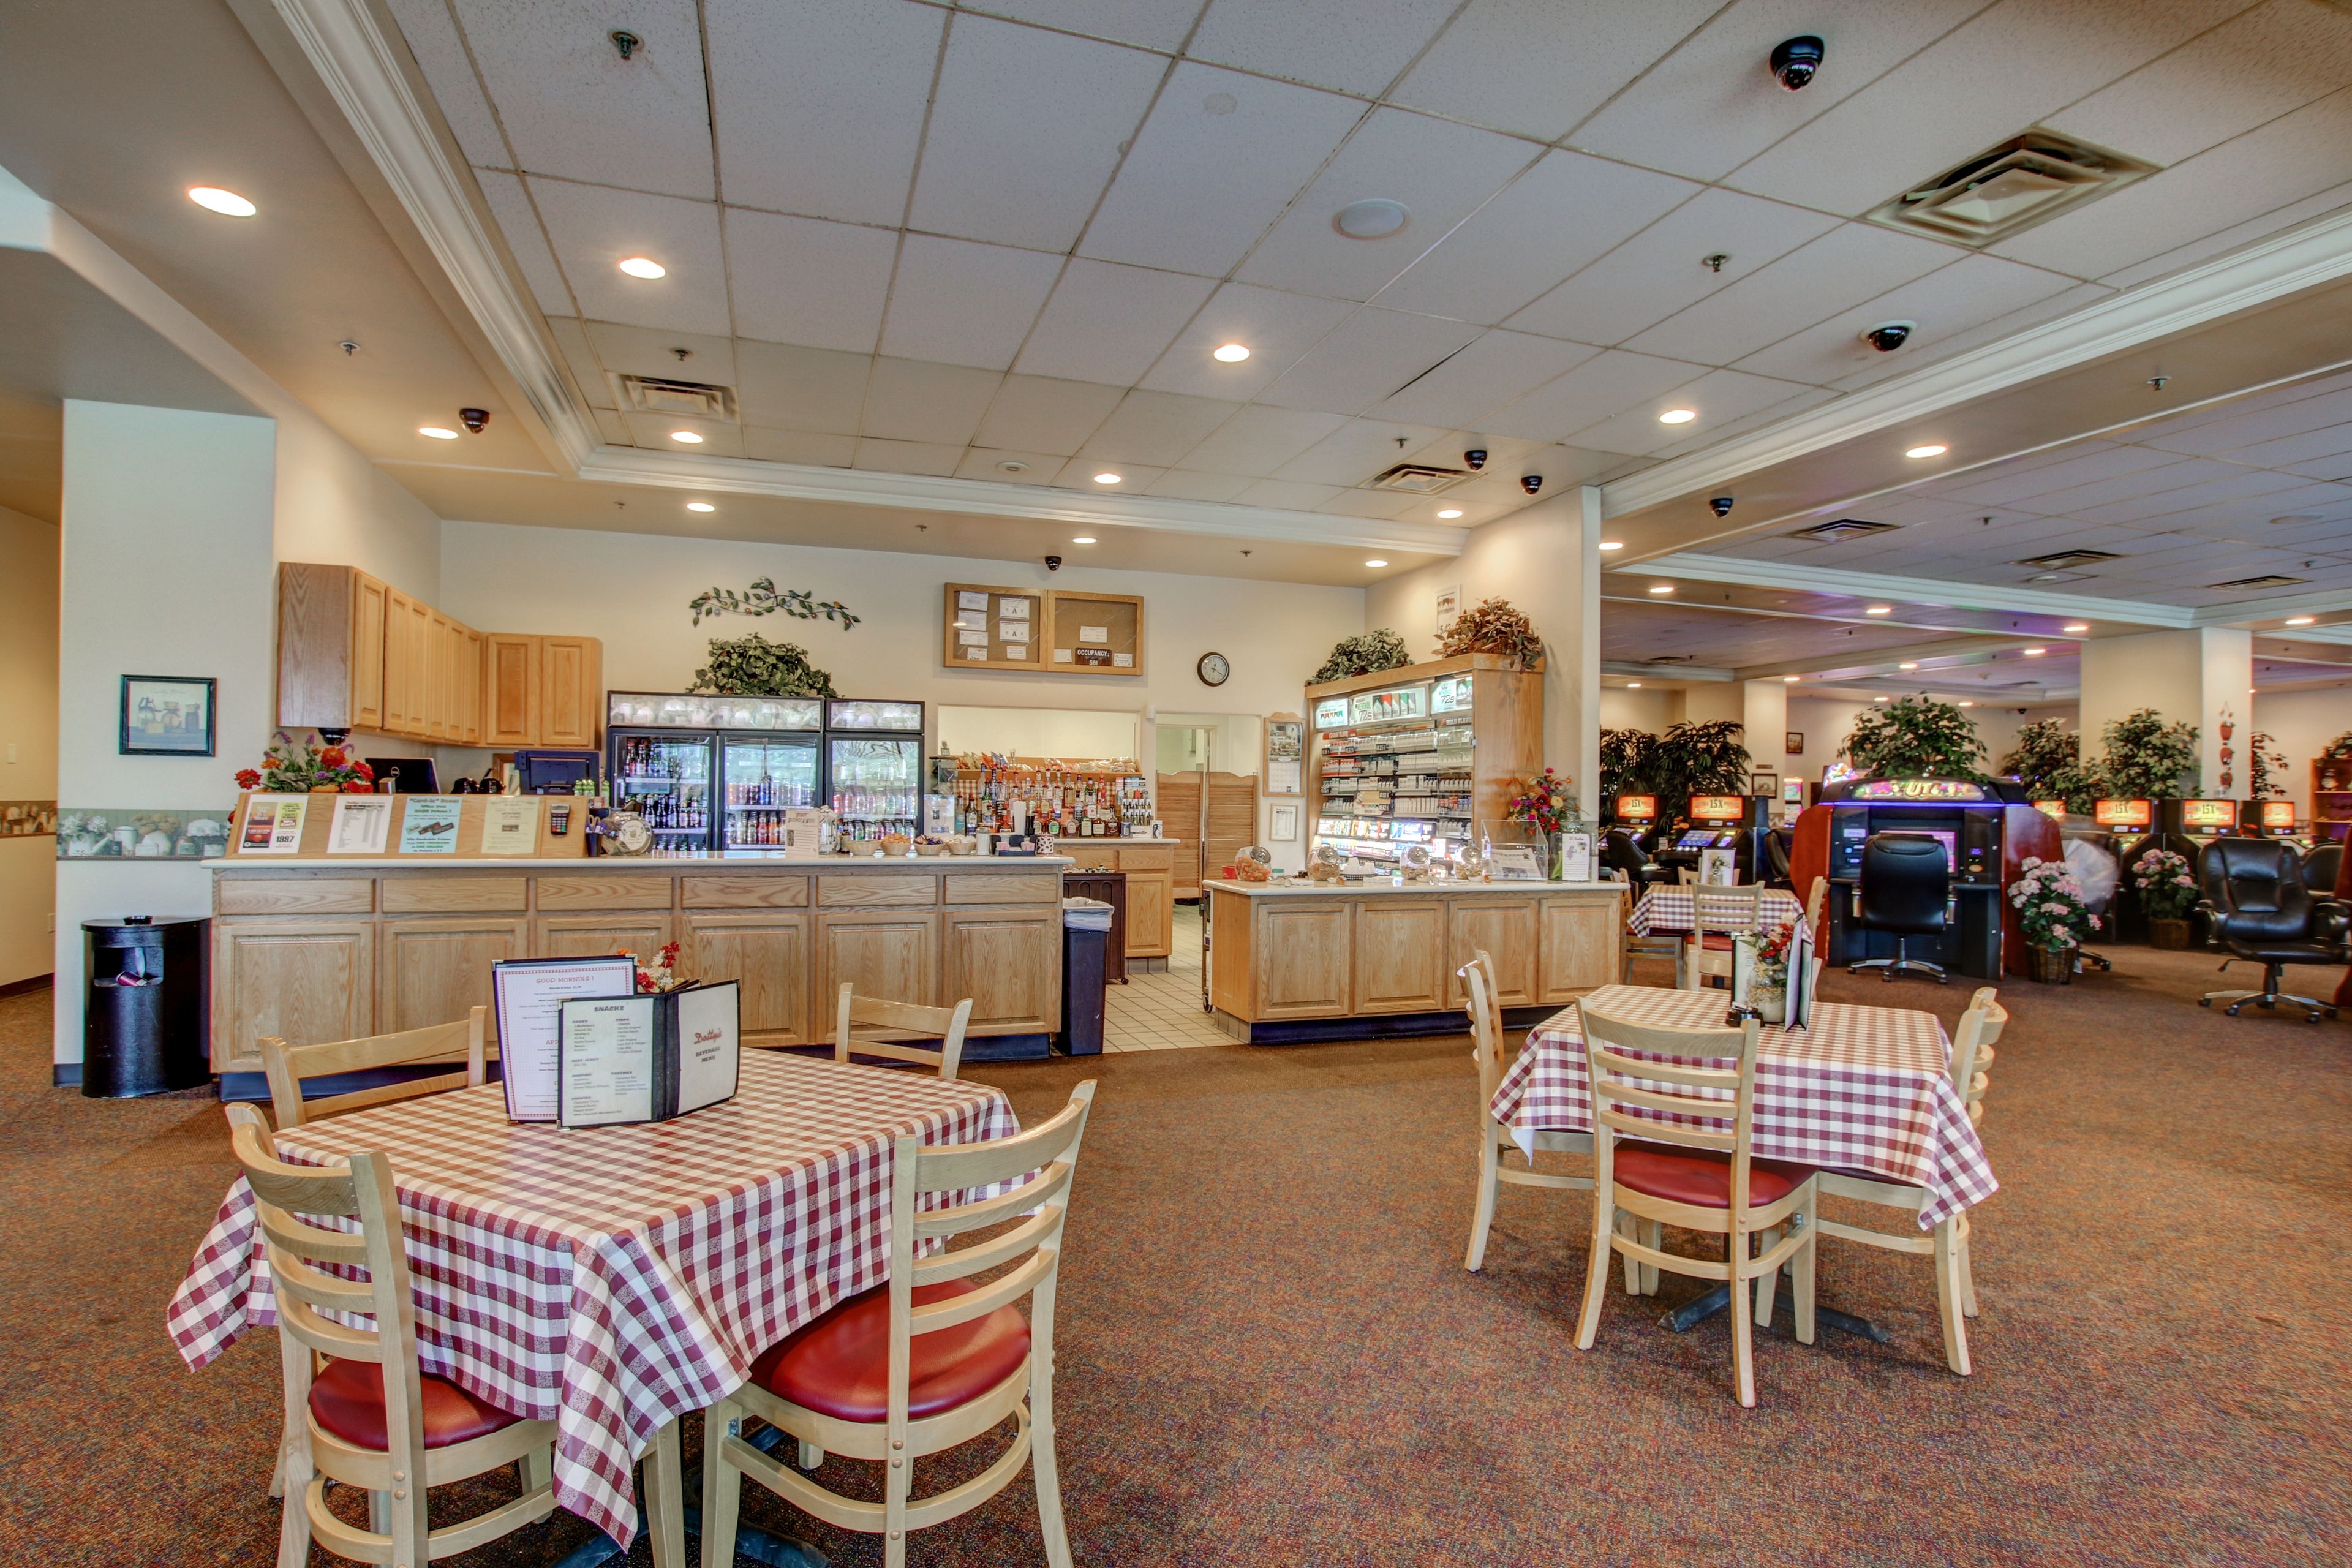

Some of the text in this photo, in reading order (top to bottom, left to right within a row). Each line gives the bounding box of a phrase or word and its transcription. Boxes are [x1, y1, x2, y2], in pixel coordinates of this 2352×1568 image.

[1441, 695, 1455, 704] 72s
[1359, 710, 1372, 722] 72s
[1632, 799, 1641, 808] 15X
[1710, 799, 1723, 808] 15X
[694, 1027, 722, 1044] Dotty's
[696, 1046, 721, 1057] BEVERAGE
